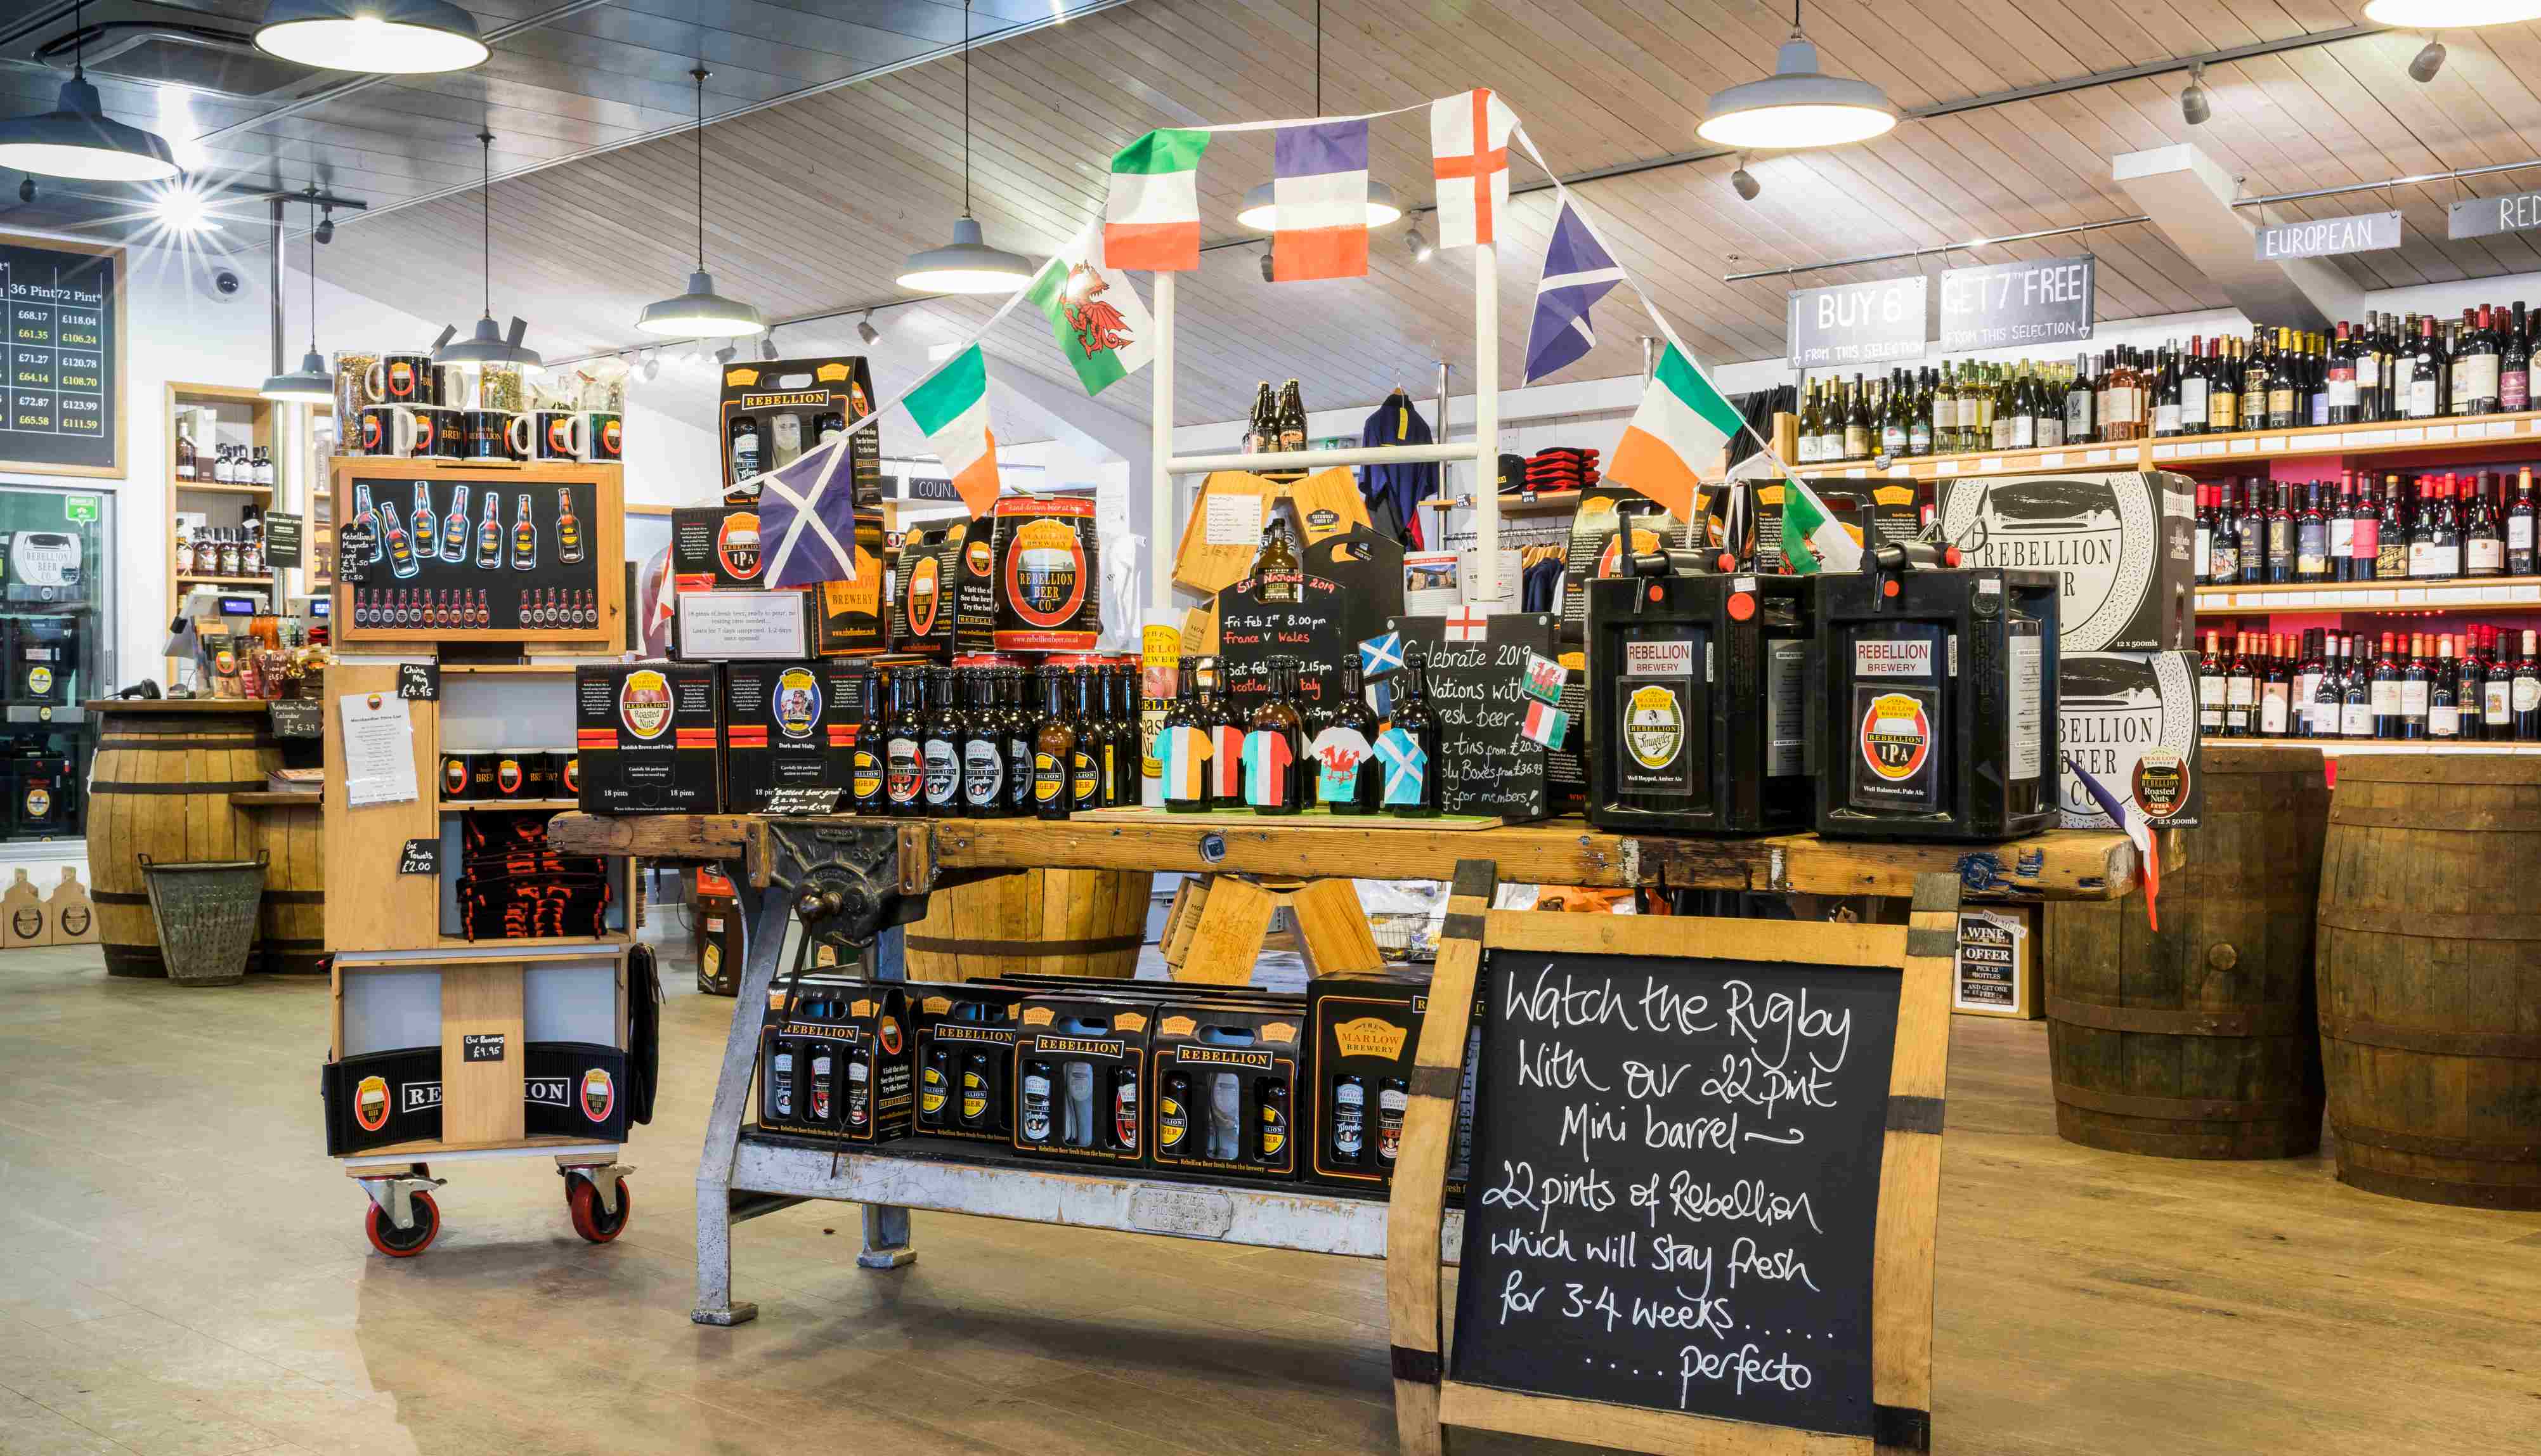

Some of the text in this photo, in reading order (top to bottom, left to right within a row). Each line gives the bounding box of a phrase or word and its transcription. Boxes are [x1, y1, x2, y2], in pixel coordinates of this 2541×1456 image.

[2266, 219, 2372, 257] EUROPEAN
[10, 283, 55, 298] 36 Pint
[57, 289, 71, 300] 72
[1942, 275, 1987, 315] GET
[2024, 265, 2082, 306] FREE
[1818, 288, 1903, 330] BUY 6
[18, 310, 48, 322] £68.17
[62, 315, 97, 326] £118.04
[18, 329, 48, 340] £61.35
[62, 334, 97, 344] £106.24
[1945, 322, 2076, 346] FROM THIS SELECTION
[1805, 340, 1925, 363] FROM THIS SELECTION
[18, 353, 49, 364] £71.27
[62, 358, 97, 368] £120.78
[18, 372, 49, 383] £64.14
[62, 376, 98, 387] £108.70
[19, 396, 49, 407] £72.87
[63, 400, 98, 411] £123.99
[746, 393, 825, 406] REBELLION
[19, 415, 49, 426] £65.58
[63, 419, 98, 430] £111.59
[734, 552, 754, 566] IPA
[1984, 538, 2112, 567] REBELLION
[1020, 572, 1073, 585] REBELLION
[1264, 573, 1304, 583] NATIONS
[1308, 578, 1335, 594] 2019
[833, 594, 873, 604] BREWERY
[1034, 586, 1059, 599] BEER
[1039, 600, 1055, 611] CO.
[1225, 615, 1241, 628] Fri
[1244, 615, 1262, 628] Feb
[1223, 631, 1259, 644] France
[1278, 631, 1309, 643] Wales
[2131, 639, 2158, 649] 500mls
[1401, 639, 1531, 669] Clebrate 2019
[1628, 644, 1689, 660] REBELLION
[1858, 644, 1928, 660] REBELLION
[403, 665, 426, 675] China
[1250, 661, 1268, 674] Feb
[1636, 663, 1679, 672] BREWERY
[1867, 663, 1916, 672] BREWERY
[412, 674, 429, 689] Mug
[401, 684, 434, 698] £4.95
[1389, 675, 1406, 701] Si
[1492, 676, 1532, 703] with
[635, 710, 660, 718] Roasted
[639, 719, 654, 728] Nuts
[1453, 731, 1485, 757] tins
[1637, 733, 1671, 755] Smuggler
[1868, 734, 1922, 743] REBELLION
[1881, 743, 1909, 763] IPA
[2060, 748, 2117, 775] BEER
[1460, 759, 1495, 782] Boxes
[613, 790, 628, 798] pints
[679, 790, 695, 798] pints
[2144, 787, 2175, 795] Roasted
[2171, 816, 2197, 826] 500mls
[408, 848, 434, 860] Towels
[402, 859, 431, 873] £2.00
[1966, 926, 2005, 940] WINE
[1966, 948, 2010, 961] OFFER
[1506, 963, 1850, 1073] Watch the Rugby
[939, 1027, 1013, 1042] REBELLION
[1341, 1033, 1400, 1045] MARLOW
[473, 1046, 500, 1058] £9.95
[1040, 1039, 1119, 1053] REBELLION
[1346, 1044, 1394, 1053] BREWERY
[1181, 1049, 1268, 1065] REBELLION
[1519, 1039, 1611, 1091] With
[1622, 1061, 1692, 1099] our
[1701, 1053, 1762, 1105] 22
[1337, 1122, 1363, 1133] Blonde
[1560, 1102, 1738, 1162] Mini barrel
[1481, 1160, 1824, 1235] 22 pints of Rebellion
[1491, 1228, 1578, 1262] which
[1587, 1230, 1636, 1268] will
[1727, 1237, 1821, 1292] fresh
[1500, 1270, 1545, 1325] for
[1562, 1283, 1622, 1332] 3-4
[1679, 1343, 1812, 1410] perfecto
